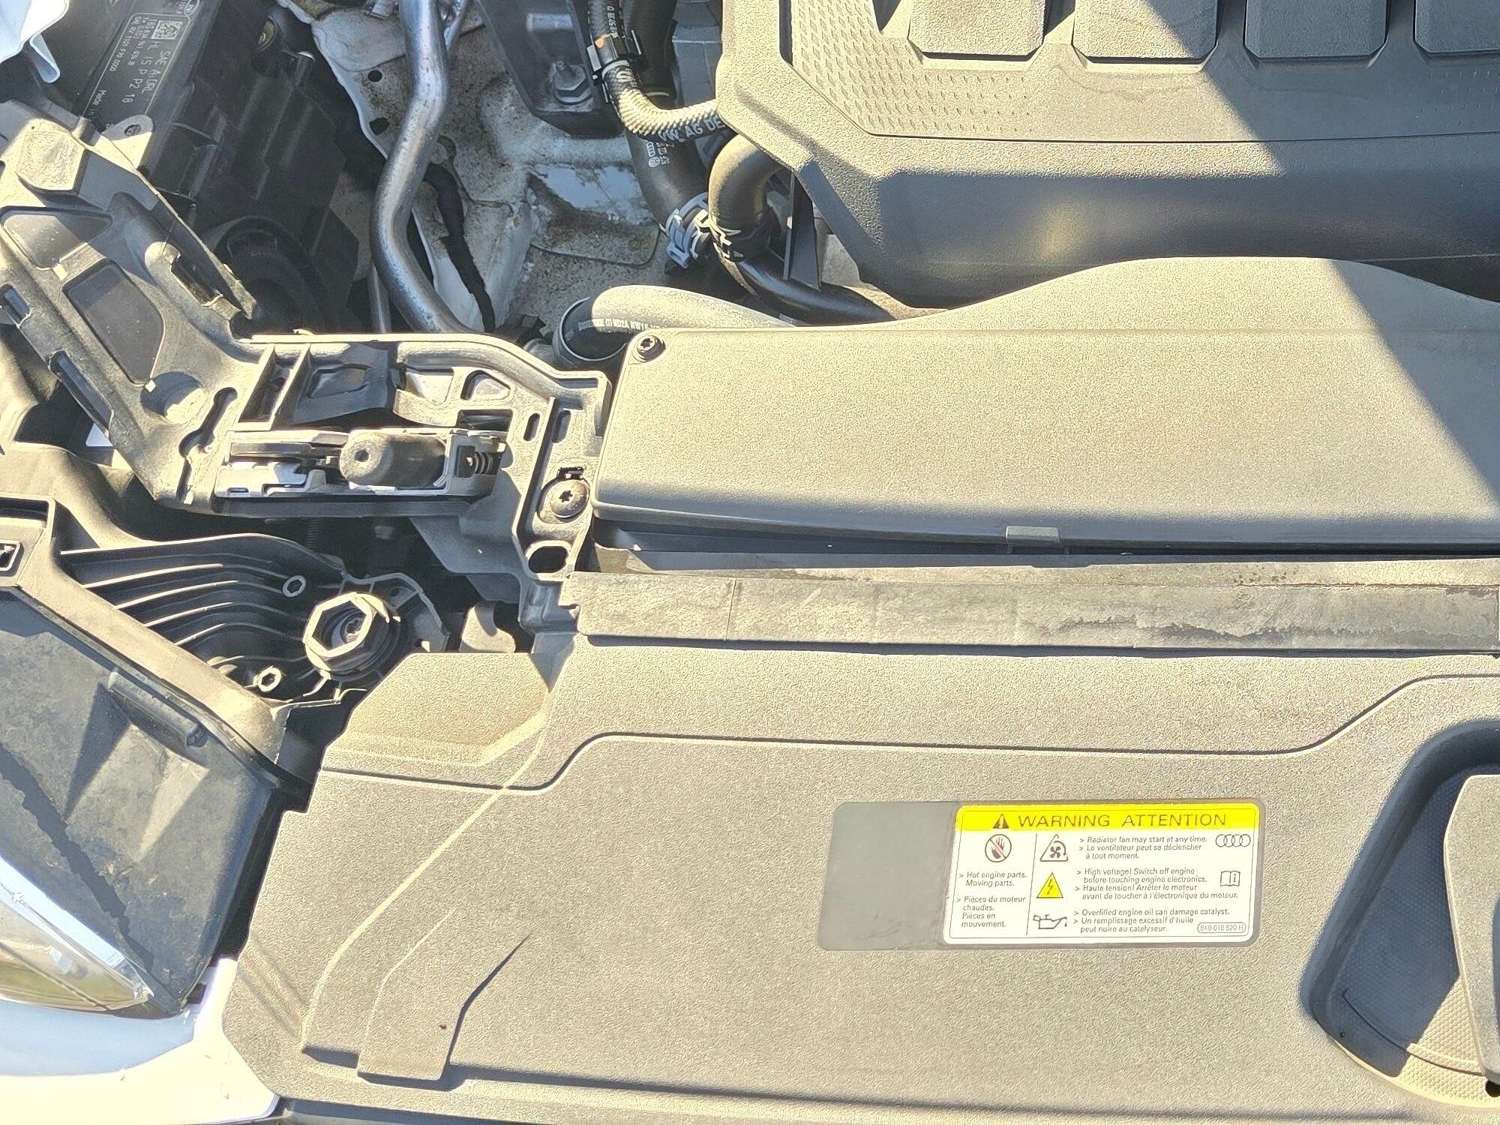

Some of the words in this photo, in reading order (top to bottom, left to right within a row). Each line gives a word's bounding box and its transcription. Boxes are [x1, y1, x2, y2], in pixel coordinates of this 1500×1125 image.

[155, 50, 171, 65] SAE
[1018, 814, 1110, 828] WARNING
[1121, 813, 1227, 827] ATTENTION
[1086, 835, 1117, 844] Radiator
[1118, 835, 1130, 844] fan
[1131, 836, 1148, 845] may
[1148, 835, 1165, 843] start
[1174, 836, 1190, 845] any
[1191, 835, 1208, 843] time.
[1136, 844, 1152, 853] peut
[1107, 852, 1140, 860] moment.
[981, 871, 1006, 880] engine
[1006, 871, 1028, 880] parts.
[1084, 868, 1101, 876] High
[1133, 867, 1158, 876] Switch
[1159, 867, 1169, 875] off
[1170, 868, 1195, 876] engine
[965, 879, 993, 888] Moving
[994, 879, 1015, 888] parts.
[1108, 876, 1140, 885] touching
[1141, 877, 1166, 885] engine
[988, 895, 998, 903] du
[1114, 892, 1142, 900] toucher
[1081, 908, 1117, 916] Overfilled
[1118, 909, 1143, 918] engine
[1144, 908, 1154, 916] oil
[1169, 908, 1199, 917] damage
[1200, 908, 1230, 917] catalyst.
[1080, 925, 1097, 934] peut
